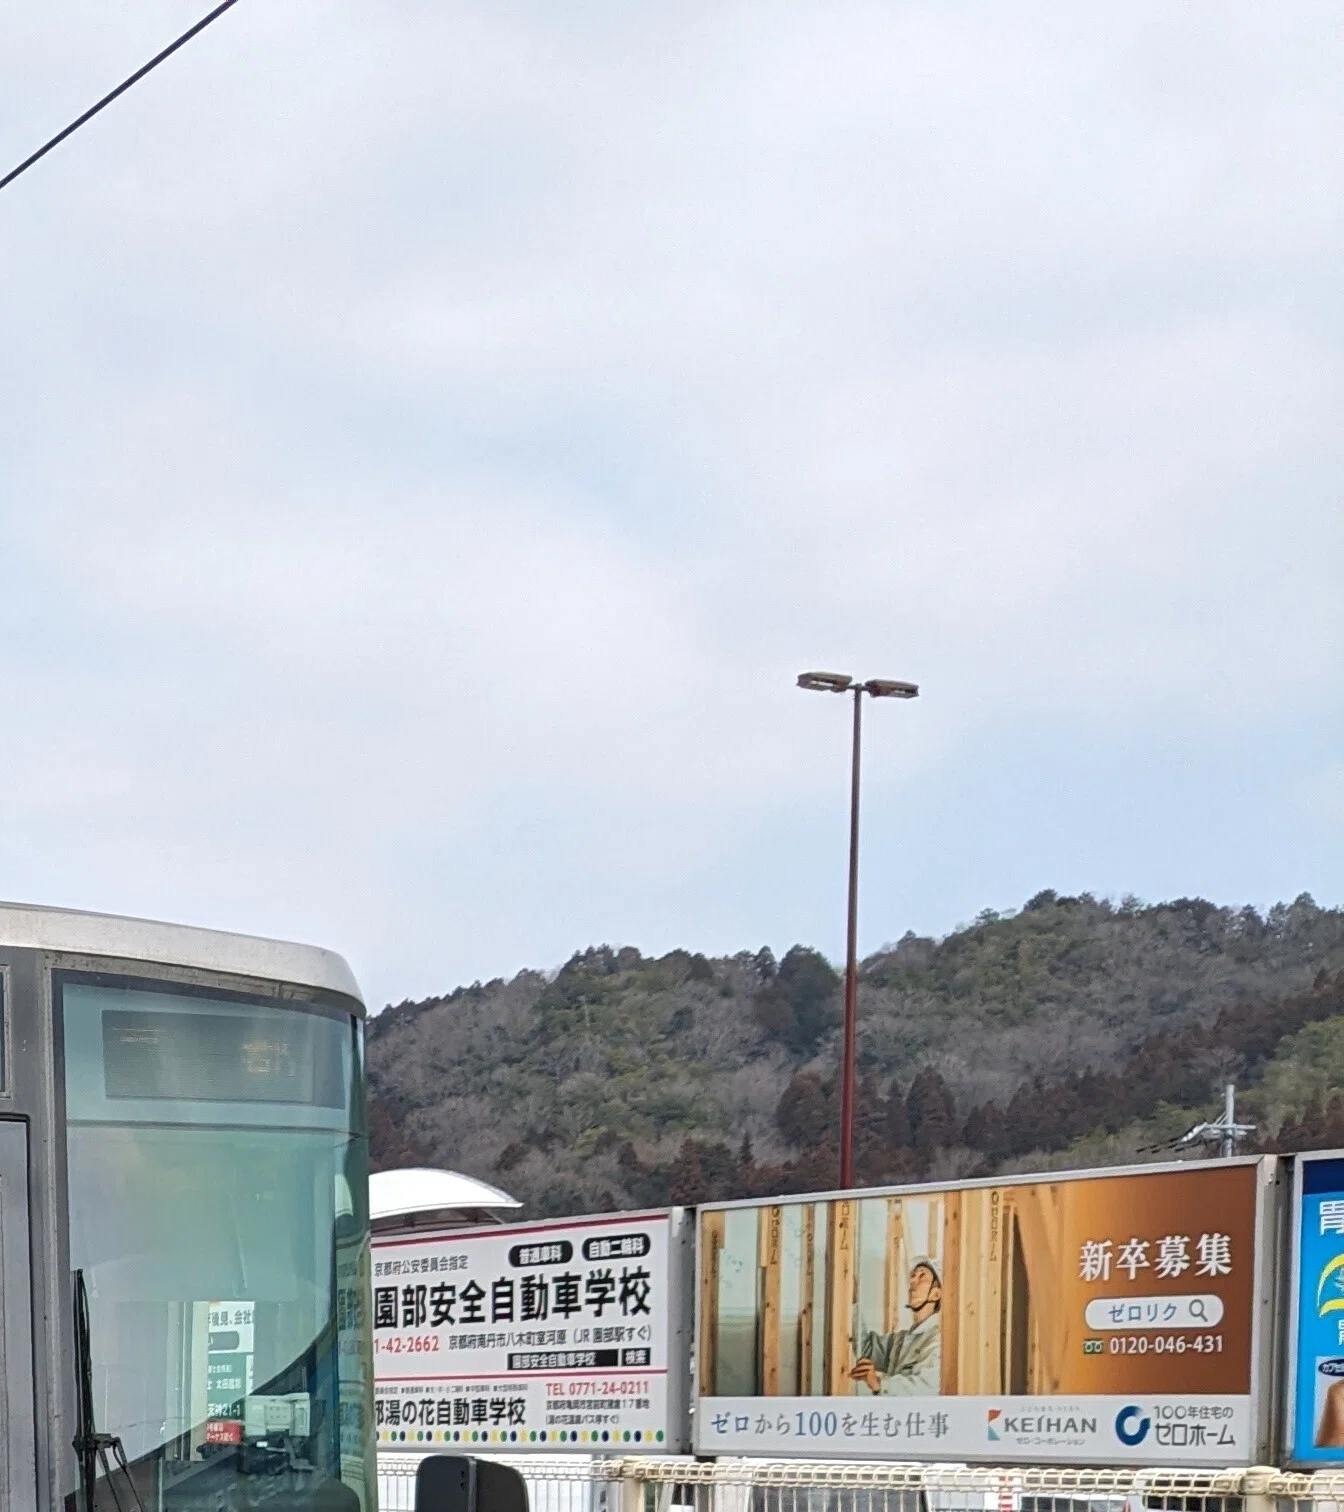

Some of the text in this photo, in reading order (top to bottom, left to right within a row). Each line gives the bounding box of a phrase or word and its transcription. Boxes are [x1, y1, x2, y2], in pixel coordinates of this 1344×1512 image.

[1078, 1232, 1234, 1283] 新卒募集
[373, 1265, 652, 1330] 園部安全自動車学校
[1108, 1303, 1179, 1324] ゼロリク
[1109, 1335, 1224, 1356] 0120-046-431
[546, 1383, 565, 1396] TEL
[569, 1380, 650, 1396] 0771-24-0211
[1153, 1405, 1234, 1419] 100年住宅の
[710, 1410, 950, 1438] ゼロから100を生む仕事
[1004, 1415, 1098, 1434] KEIHAN
[1154, 1423, 1237, 1447] ゼロホーム
